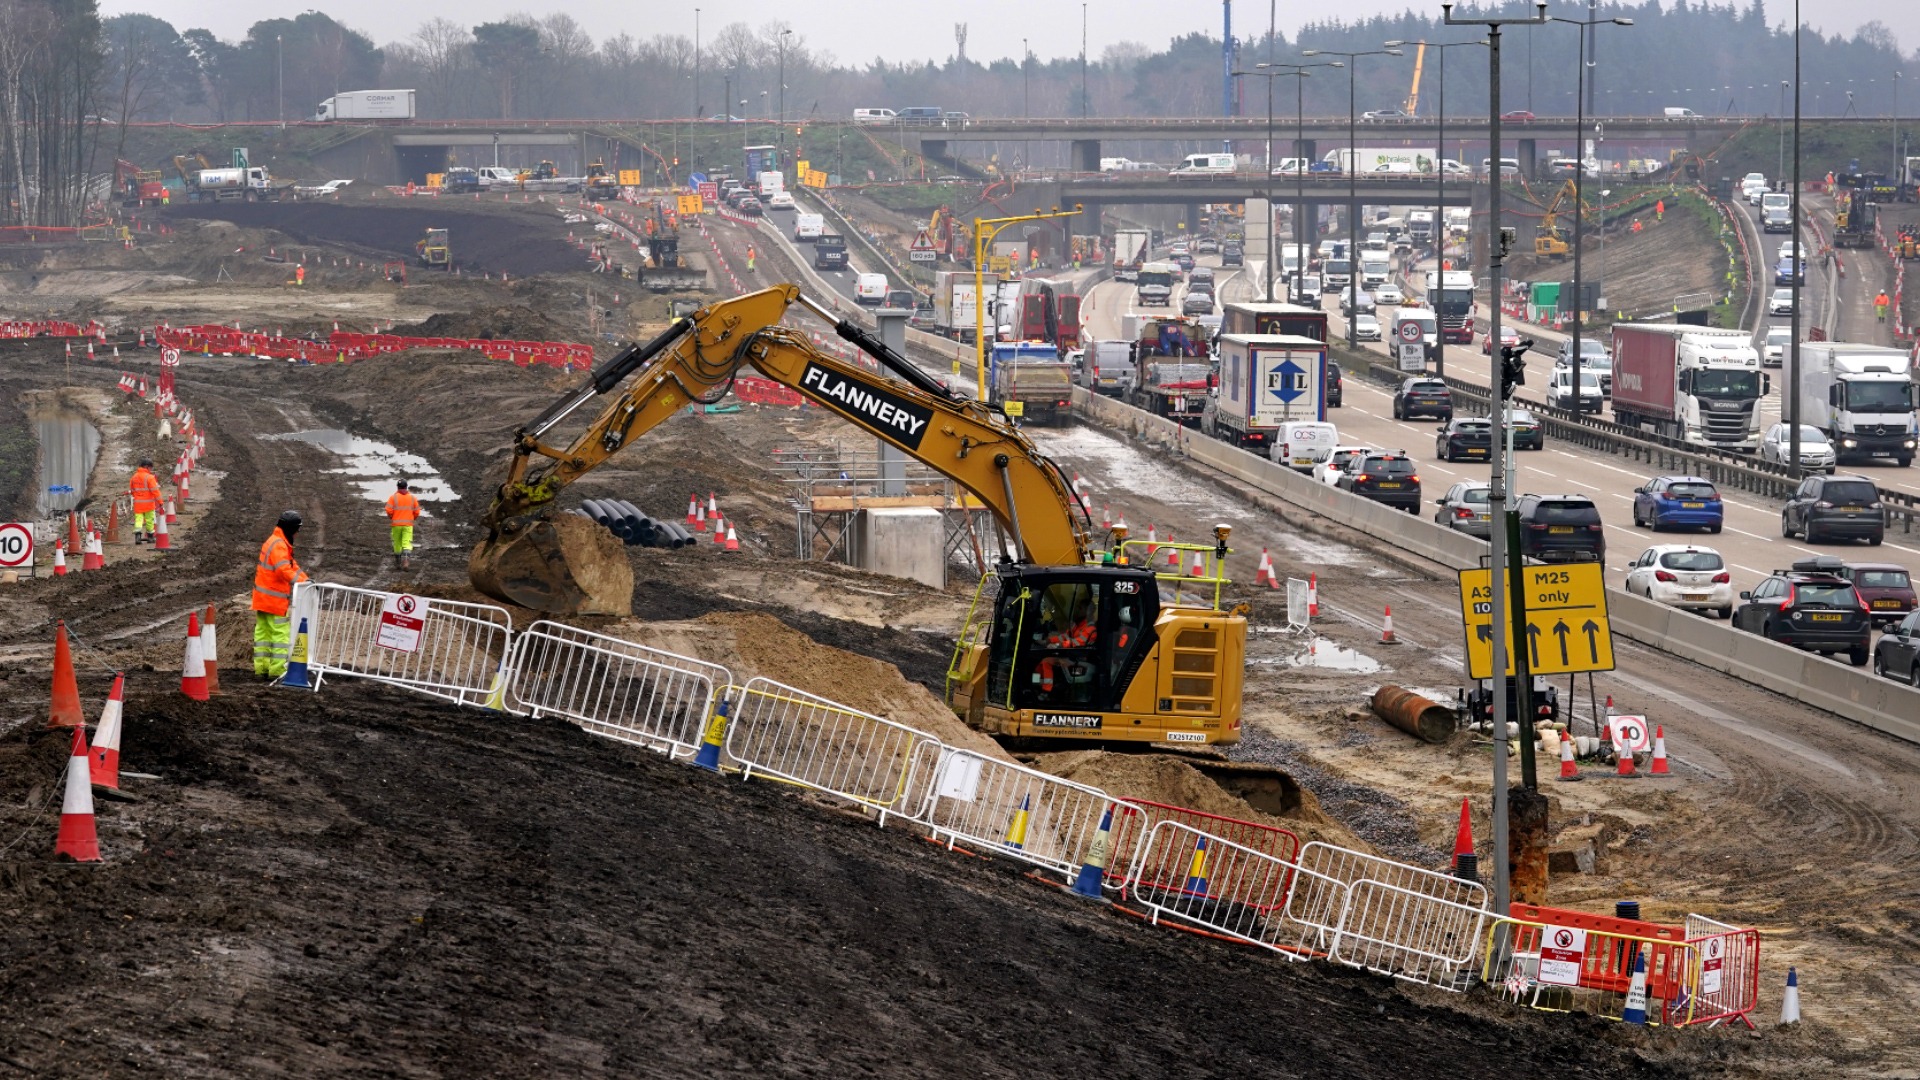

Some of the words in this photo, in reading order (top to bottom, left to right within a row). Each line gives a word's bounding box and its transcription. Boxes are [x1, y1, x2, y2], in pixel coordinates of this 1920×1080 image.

[1386, 155, 1411, 163] brakes
[204, 175, 222, 183] T&M
[923, 252, 935, 260] yds
[1403, 327, 1418, 336] 50
[1267, 373, 1308, 389] FTL
[803, 366, 926, 435] FLANNERY
[1294, 430, 1316, 440] OCS
[0, 535, 23, 554] 10
[1535, 571, 1570, 585] M25
[1113, 580, 1135, 594] 325
[1538, 590, 1570, 603] only
[1474, 603, 1491, 613] 10
[1035, 714, 1100, 727] FLANNERY
